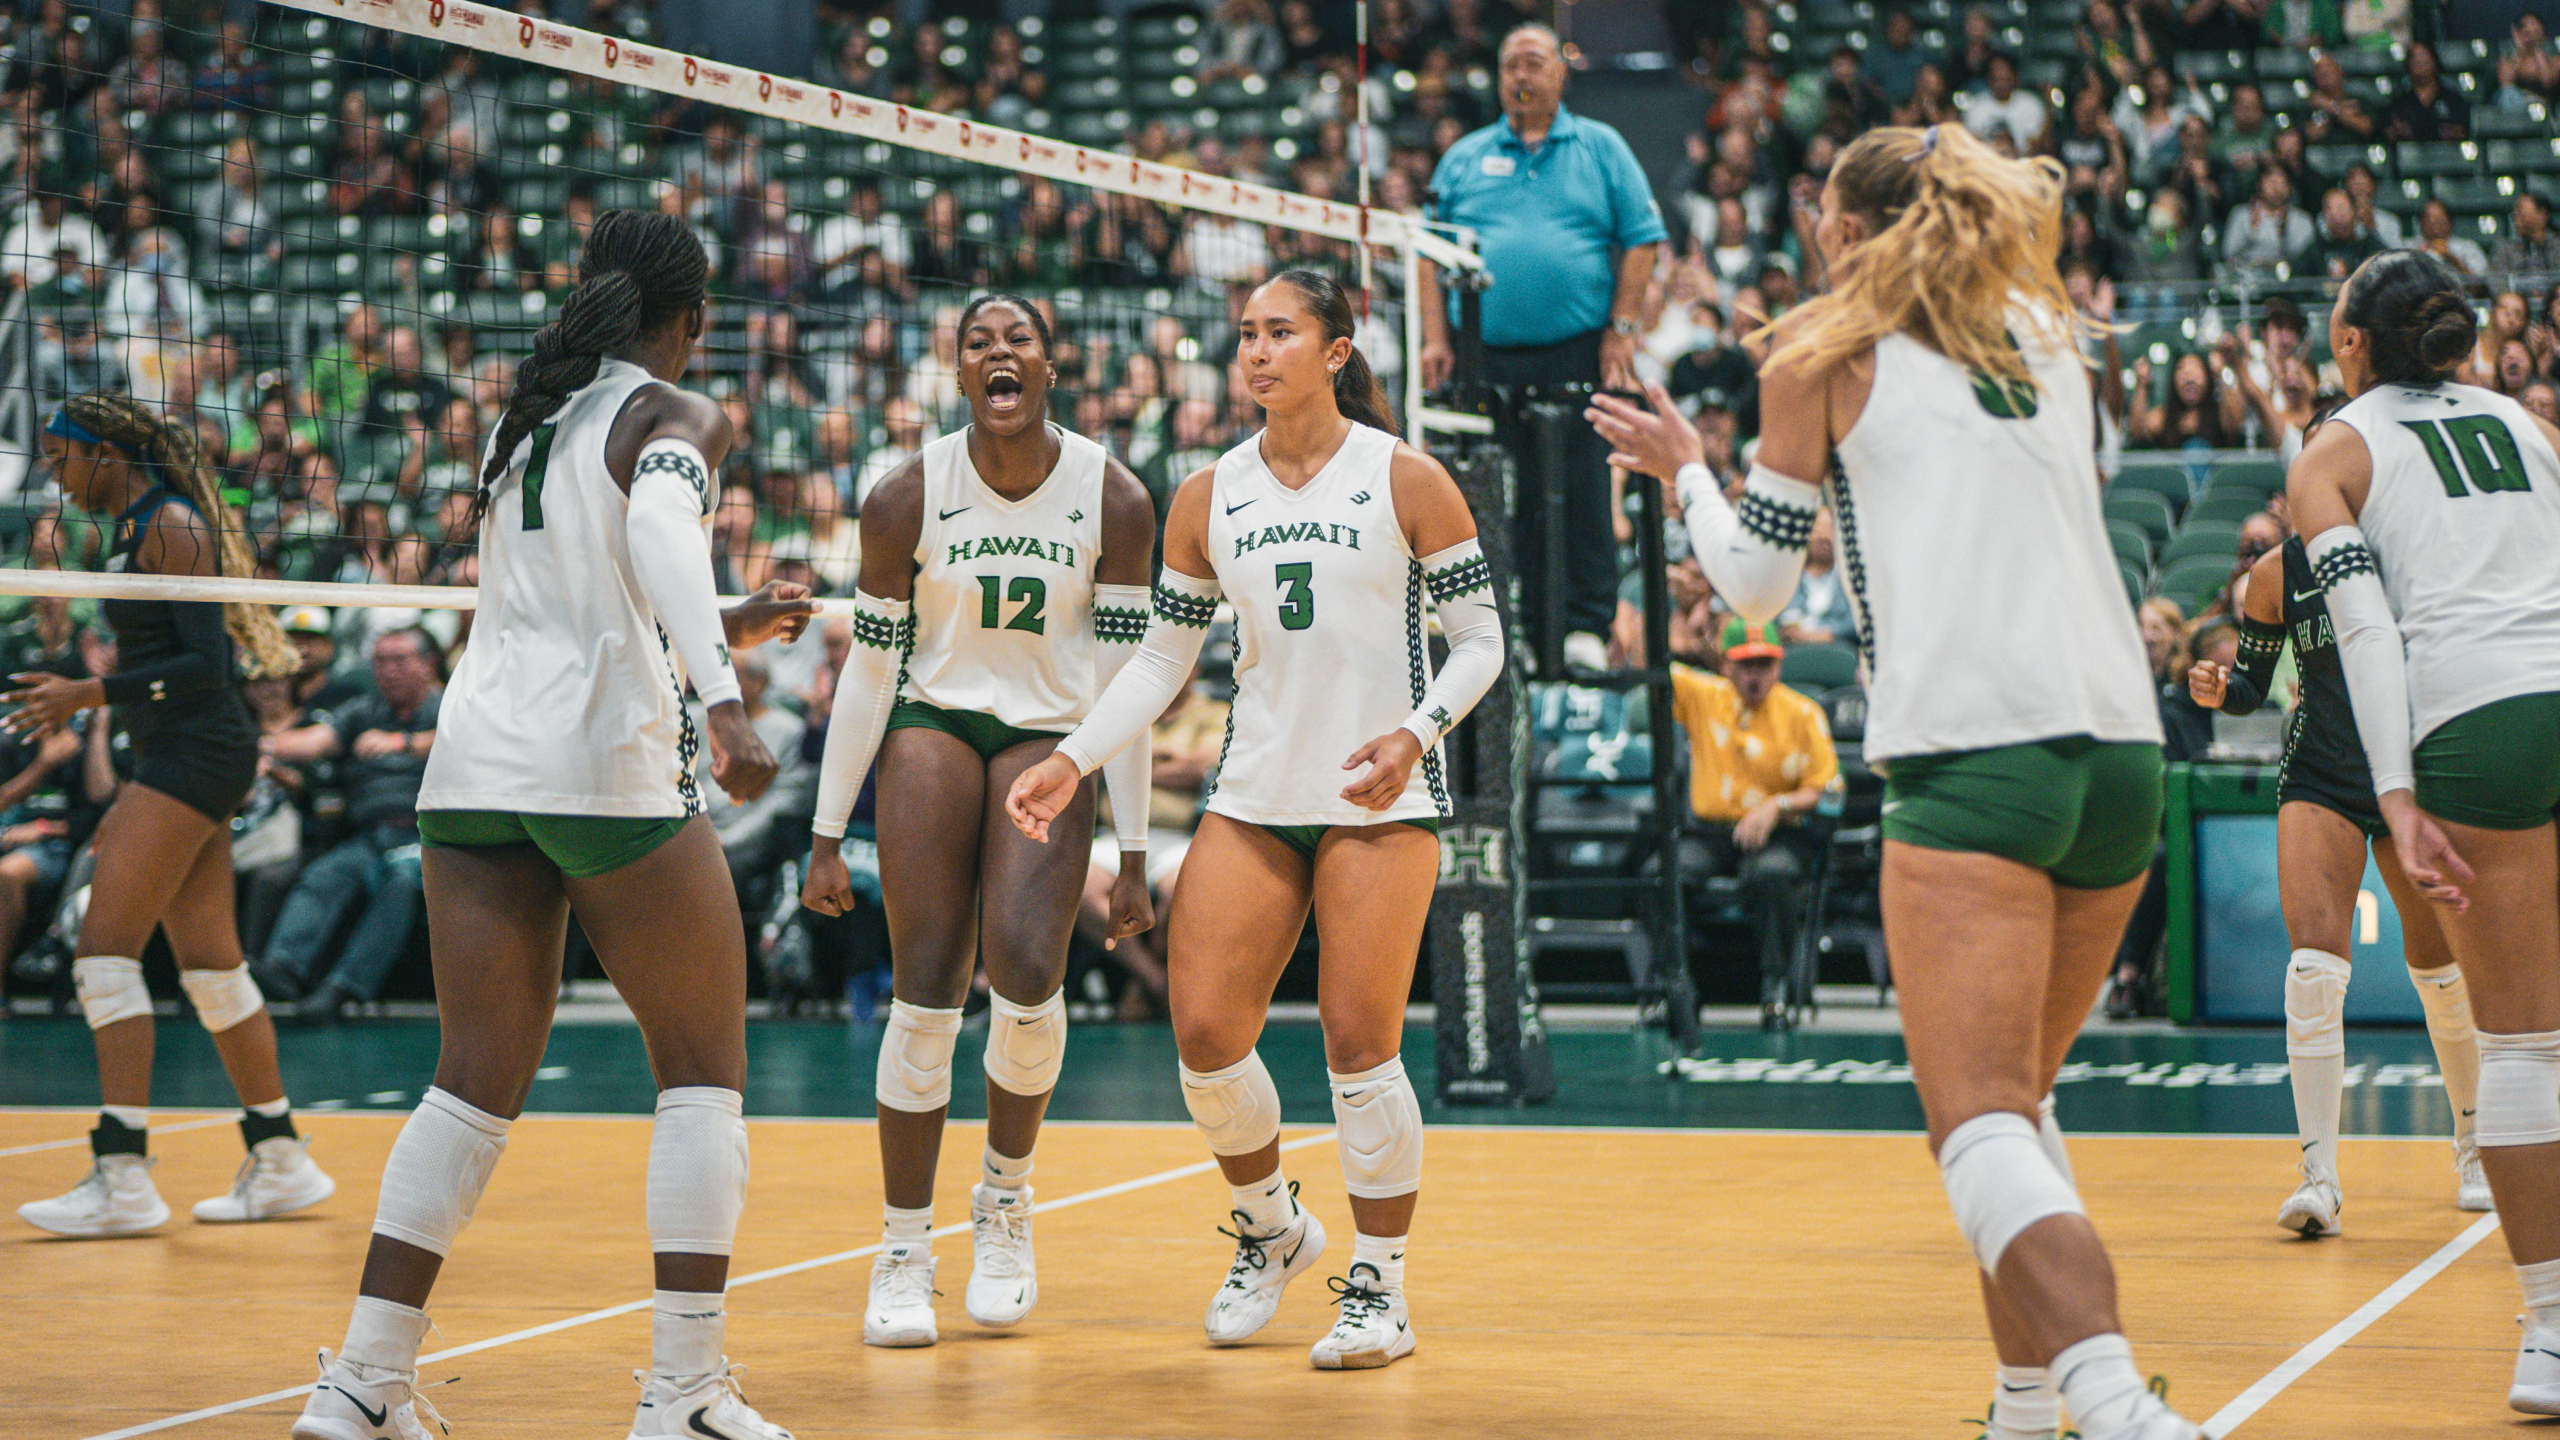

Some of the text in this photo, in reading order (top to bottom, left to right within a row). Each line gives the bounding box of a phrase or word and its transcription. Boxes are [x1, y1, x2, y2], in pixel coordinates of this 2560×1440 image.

[2398, 414, 2532, 498] 10
[947, 536, 1075, 568] HAWAI'I
[1234, 522, 1361, 560] HAWAI'I
[975, 575, 1046, 636] 12
[1275, 562, 1314, 631] 3
[2296, 614, 2336, 652] HA
